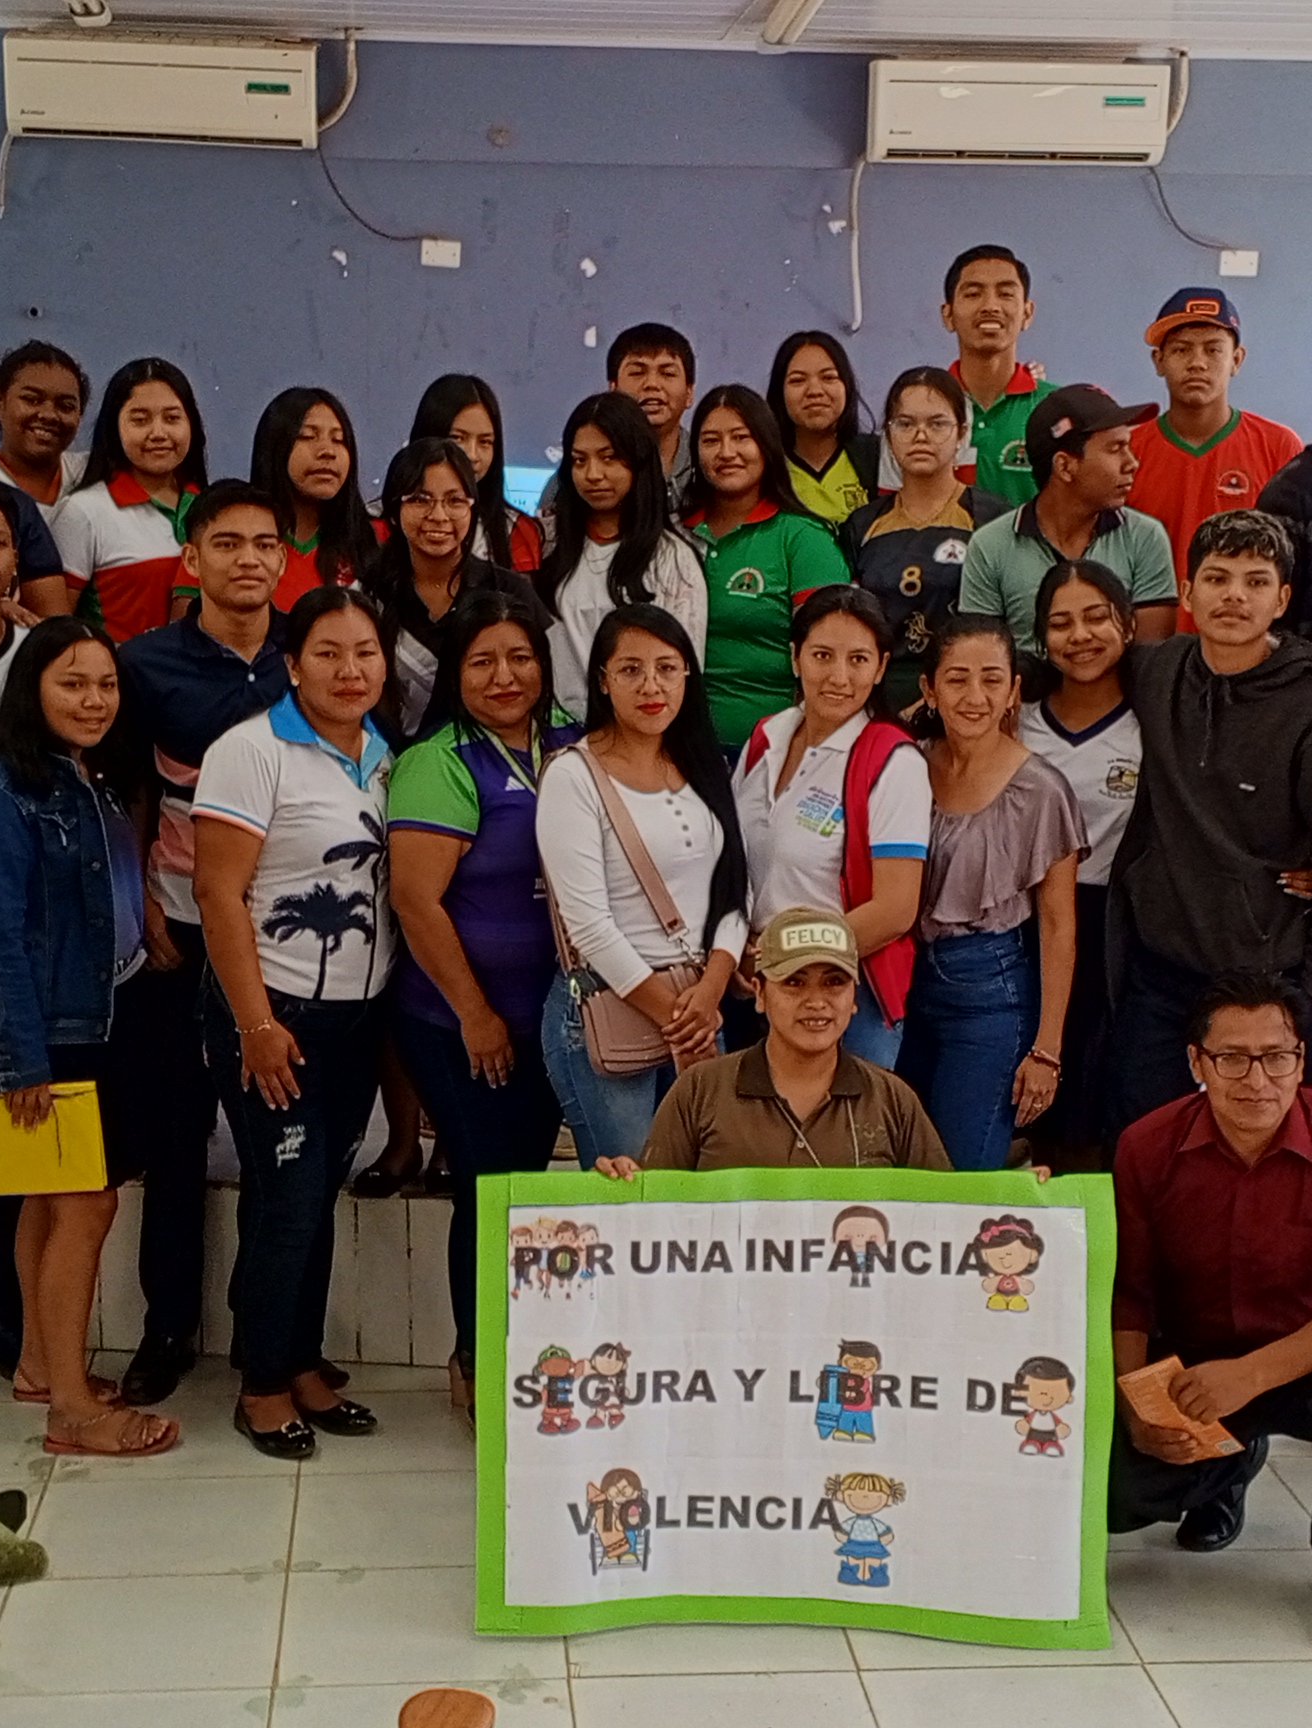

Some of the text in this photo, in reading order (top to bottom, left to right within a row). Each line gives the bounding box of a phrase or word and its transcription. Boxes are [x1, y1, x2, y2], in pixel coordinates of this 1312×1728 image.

[899, 564, 922, 597] 8
[514, 1238, 988, 1277] POR UNA INFANCIA
[512, 1368, 1030, 1417] SEGURA Y LIBRE DE
[567, 1495, 844, 1536] VIOLENCIA
